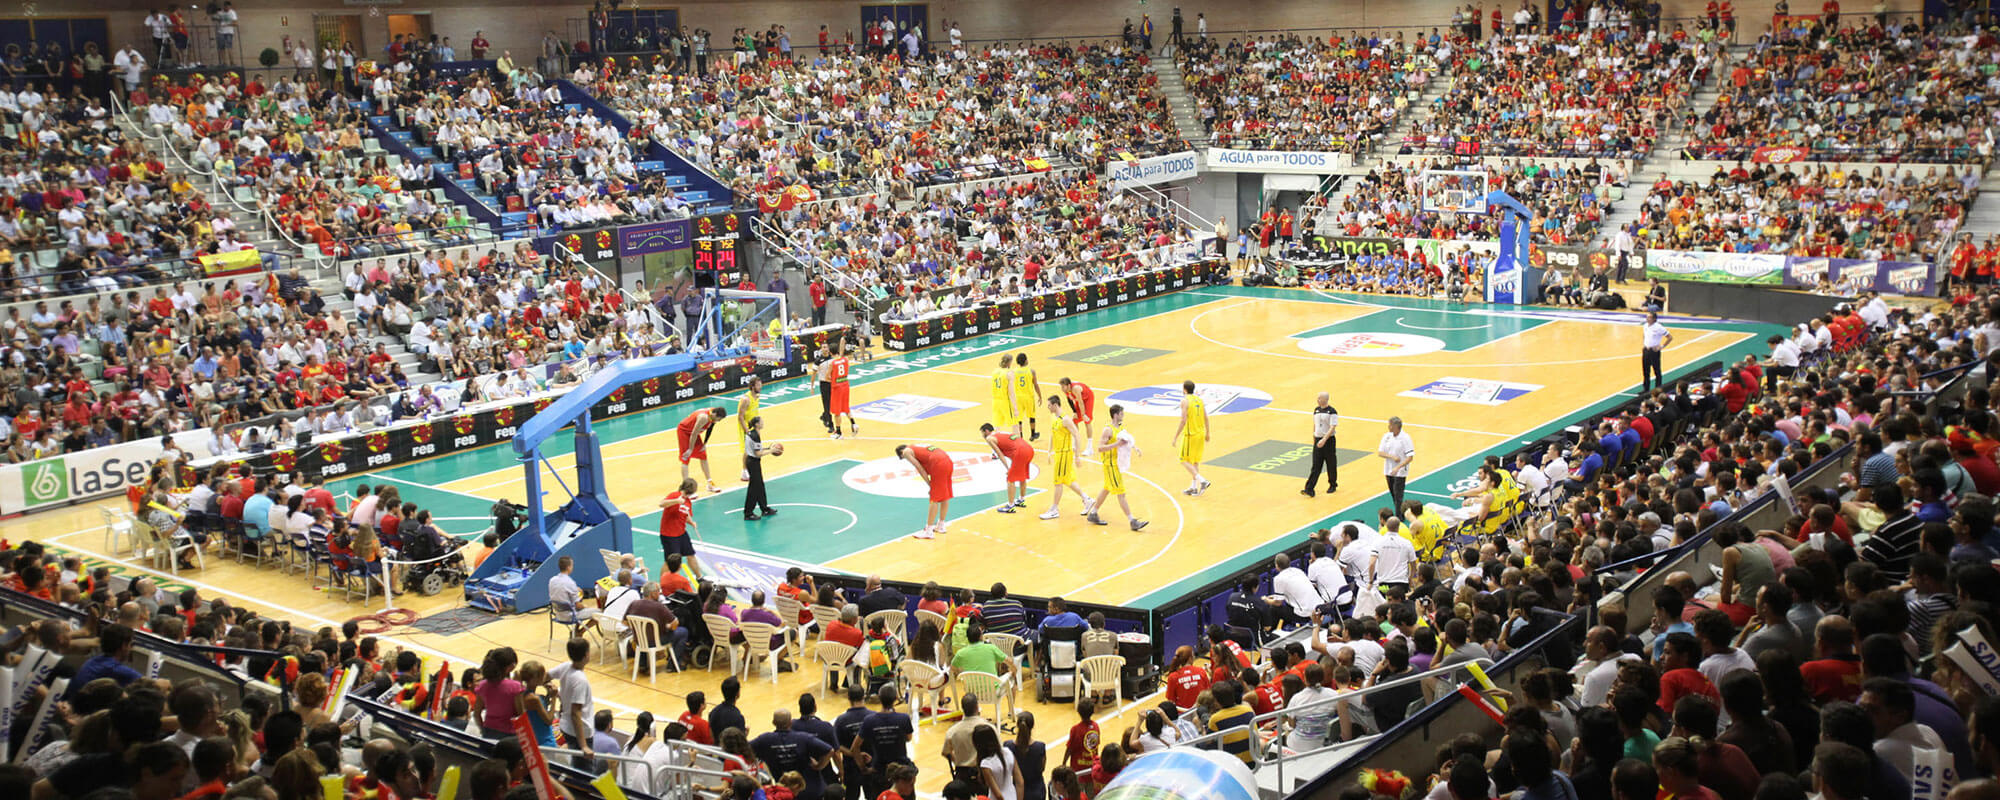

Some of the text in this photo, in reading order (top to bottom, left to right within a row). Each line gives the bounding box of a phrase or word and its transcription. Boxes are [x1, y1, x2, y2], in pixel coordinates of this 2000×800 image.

[1220, 151, 1326, 166] AGUA para TODOS
[1114, 157, 1195, 182] AGUA para TODOS
[1313, 236, 1388, 265] Bnkia
[696, 250, 736, 270] 24 24
[838, 364, 845, 376] 8
[1020, 376, 1026, 387] 5
[1086, 632, 1110, 643] 22
